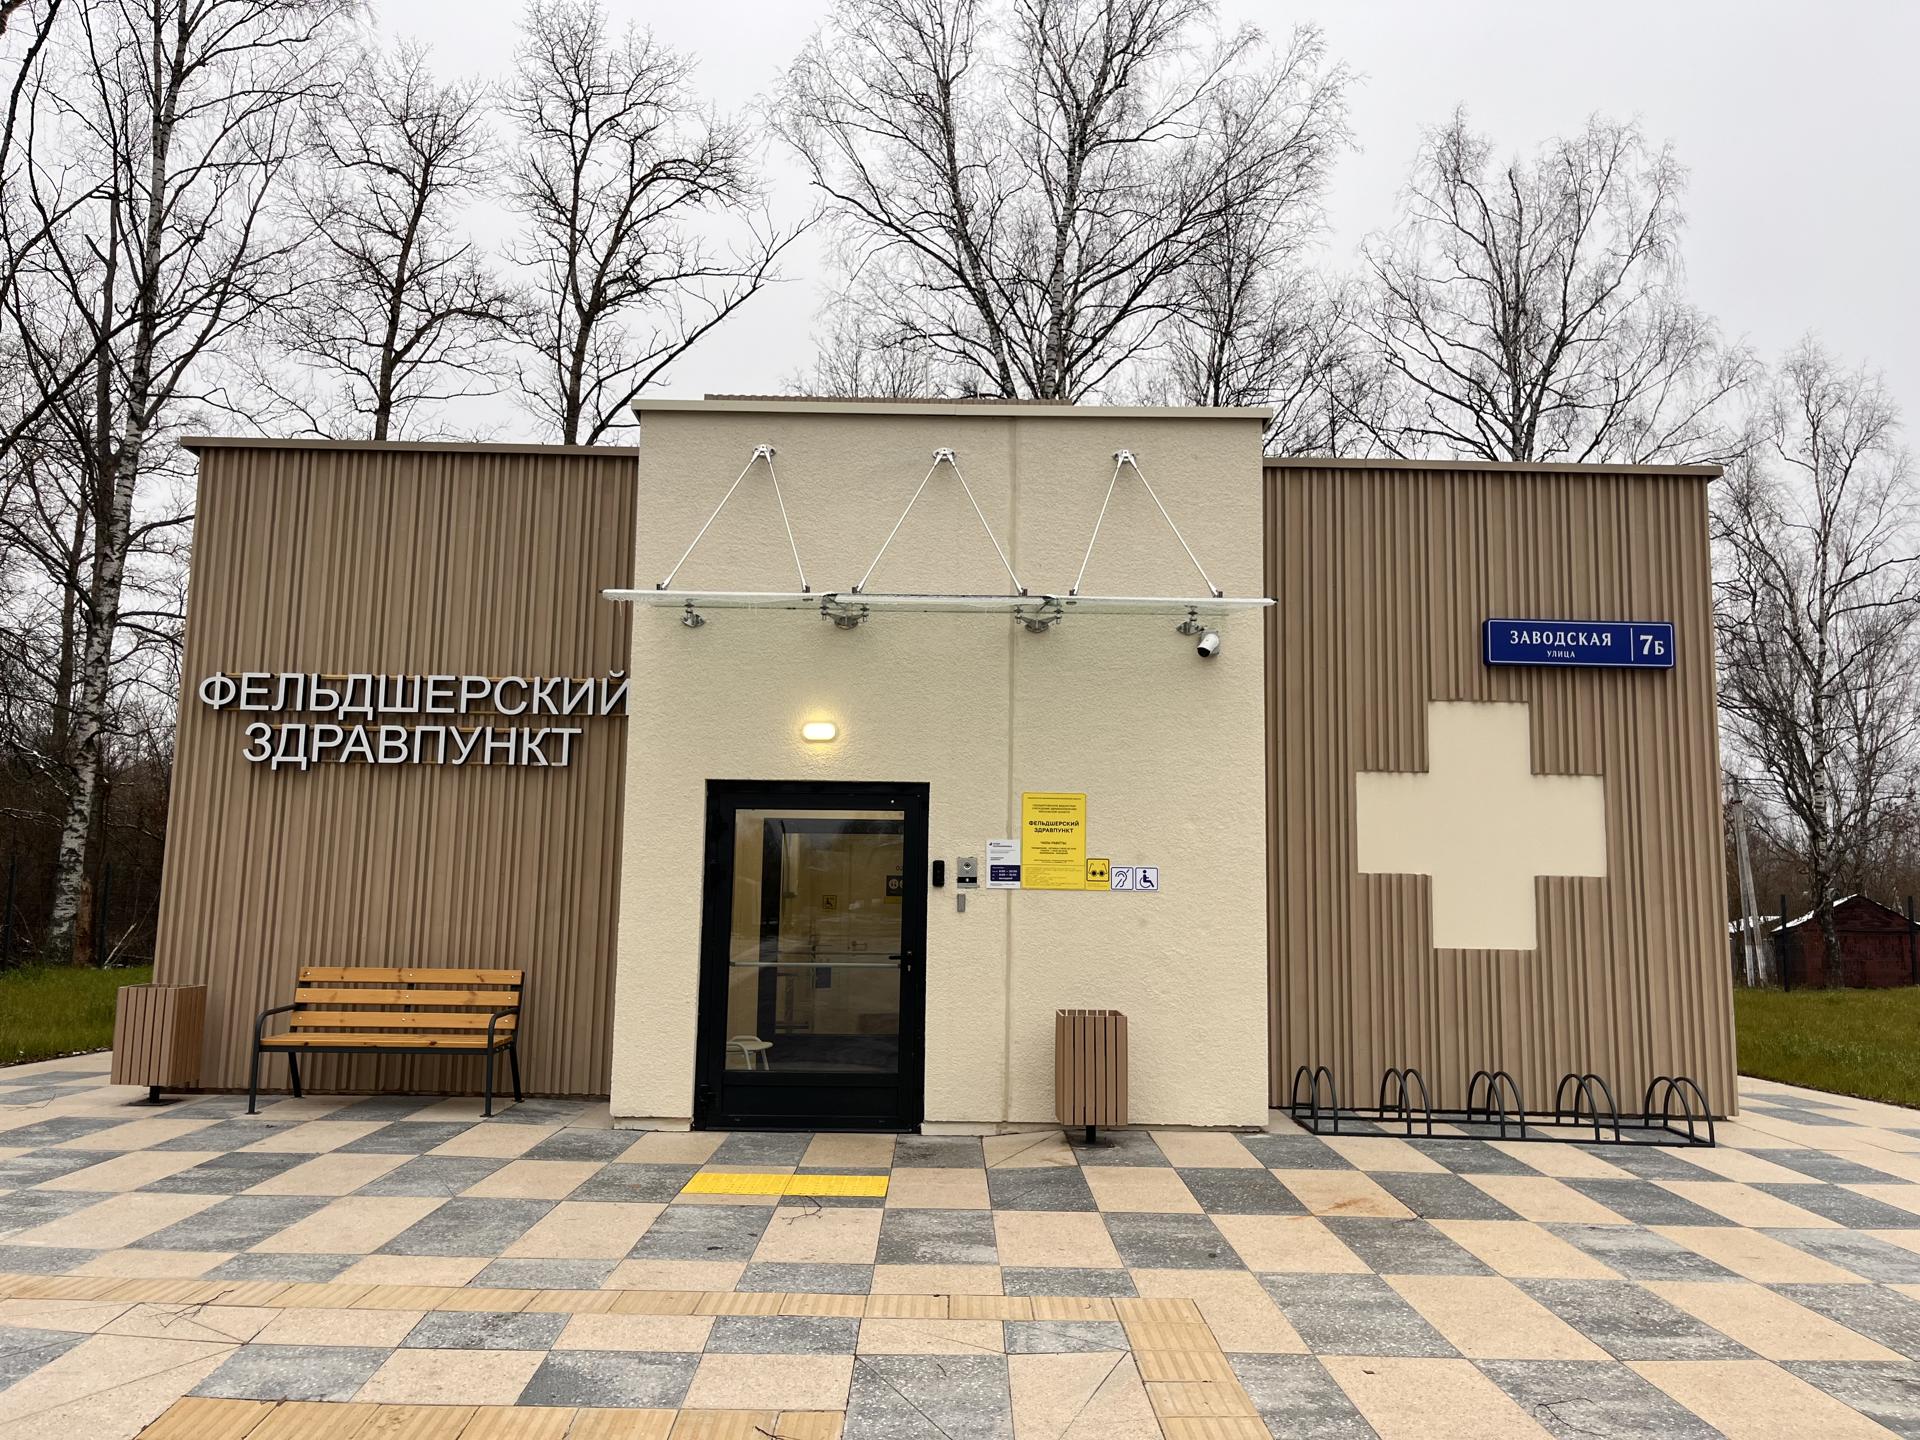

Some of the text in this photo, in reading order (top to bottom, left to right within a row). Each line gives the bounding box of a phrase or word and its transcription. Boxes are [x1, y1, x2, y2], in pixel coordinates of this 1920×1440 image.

[1510, 630, 1664, 655] ЗАВОДСКАЯ 7Б
[1547, 650, 1575, 658] УЛИЦА
[198, 670, 630, 720] ФЕЛЬДШЕРСКИЙ
[242, 723, 582, 770] ЗДРАВПУНКТ
